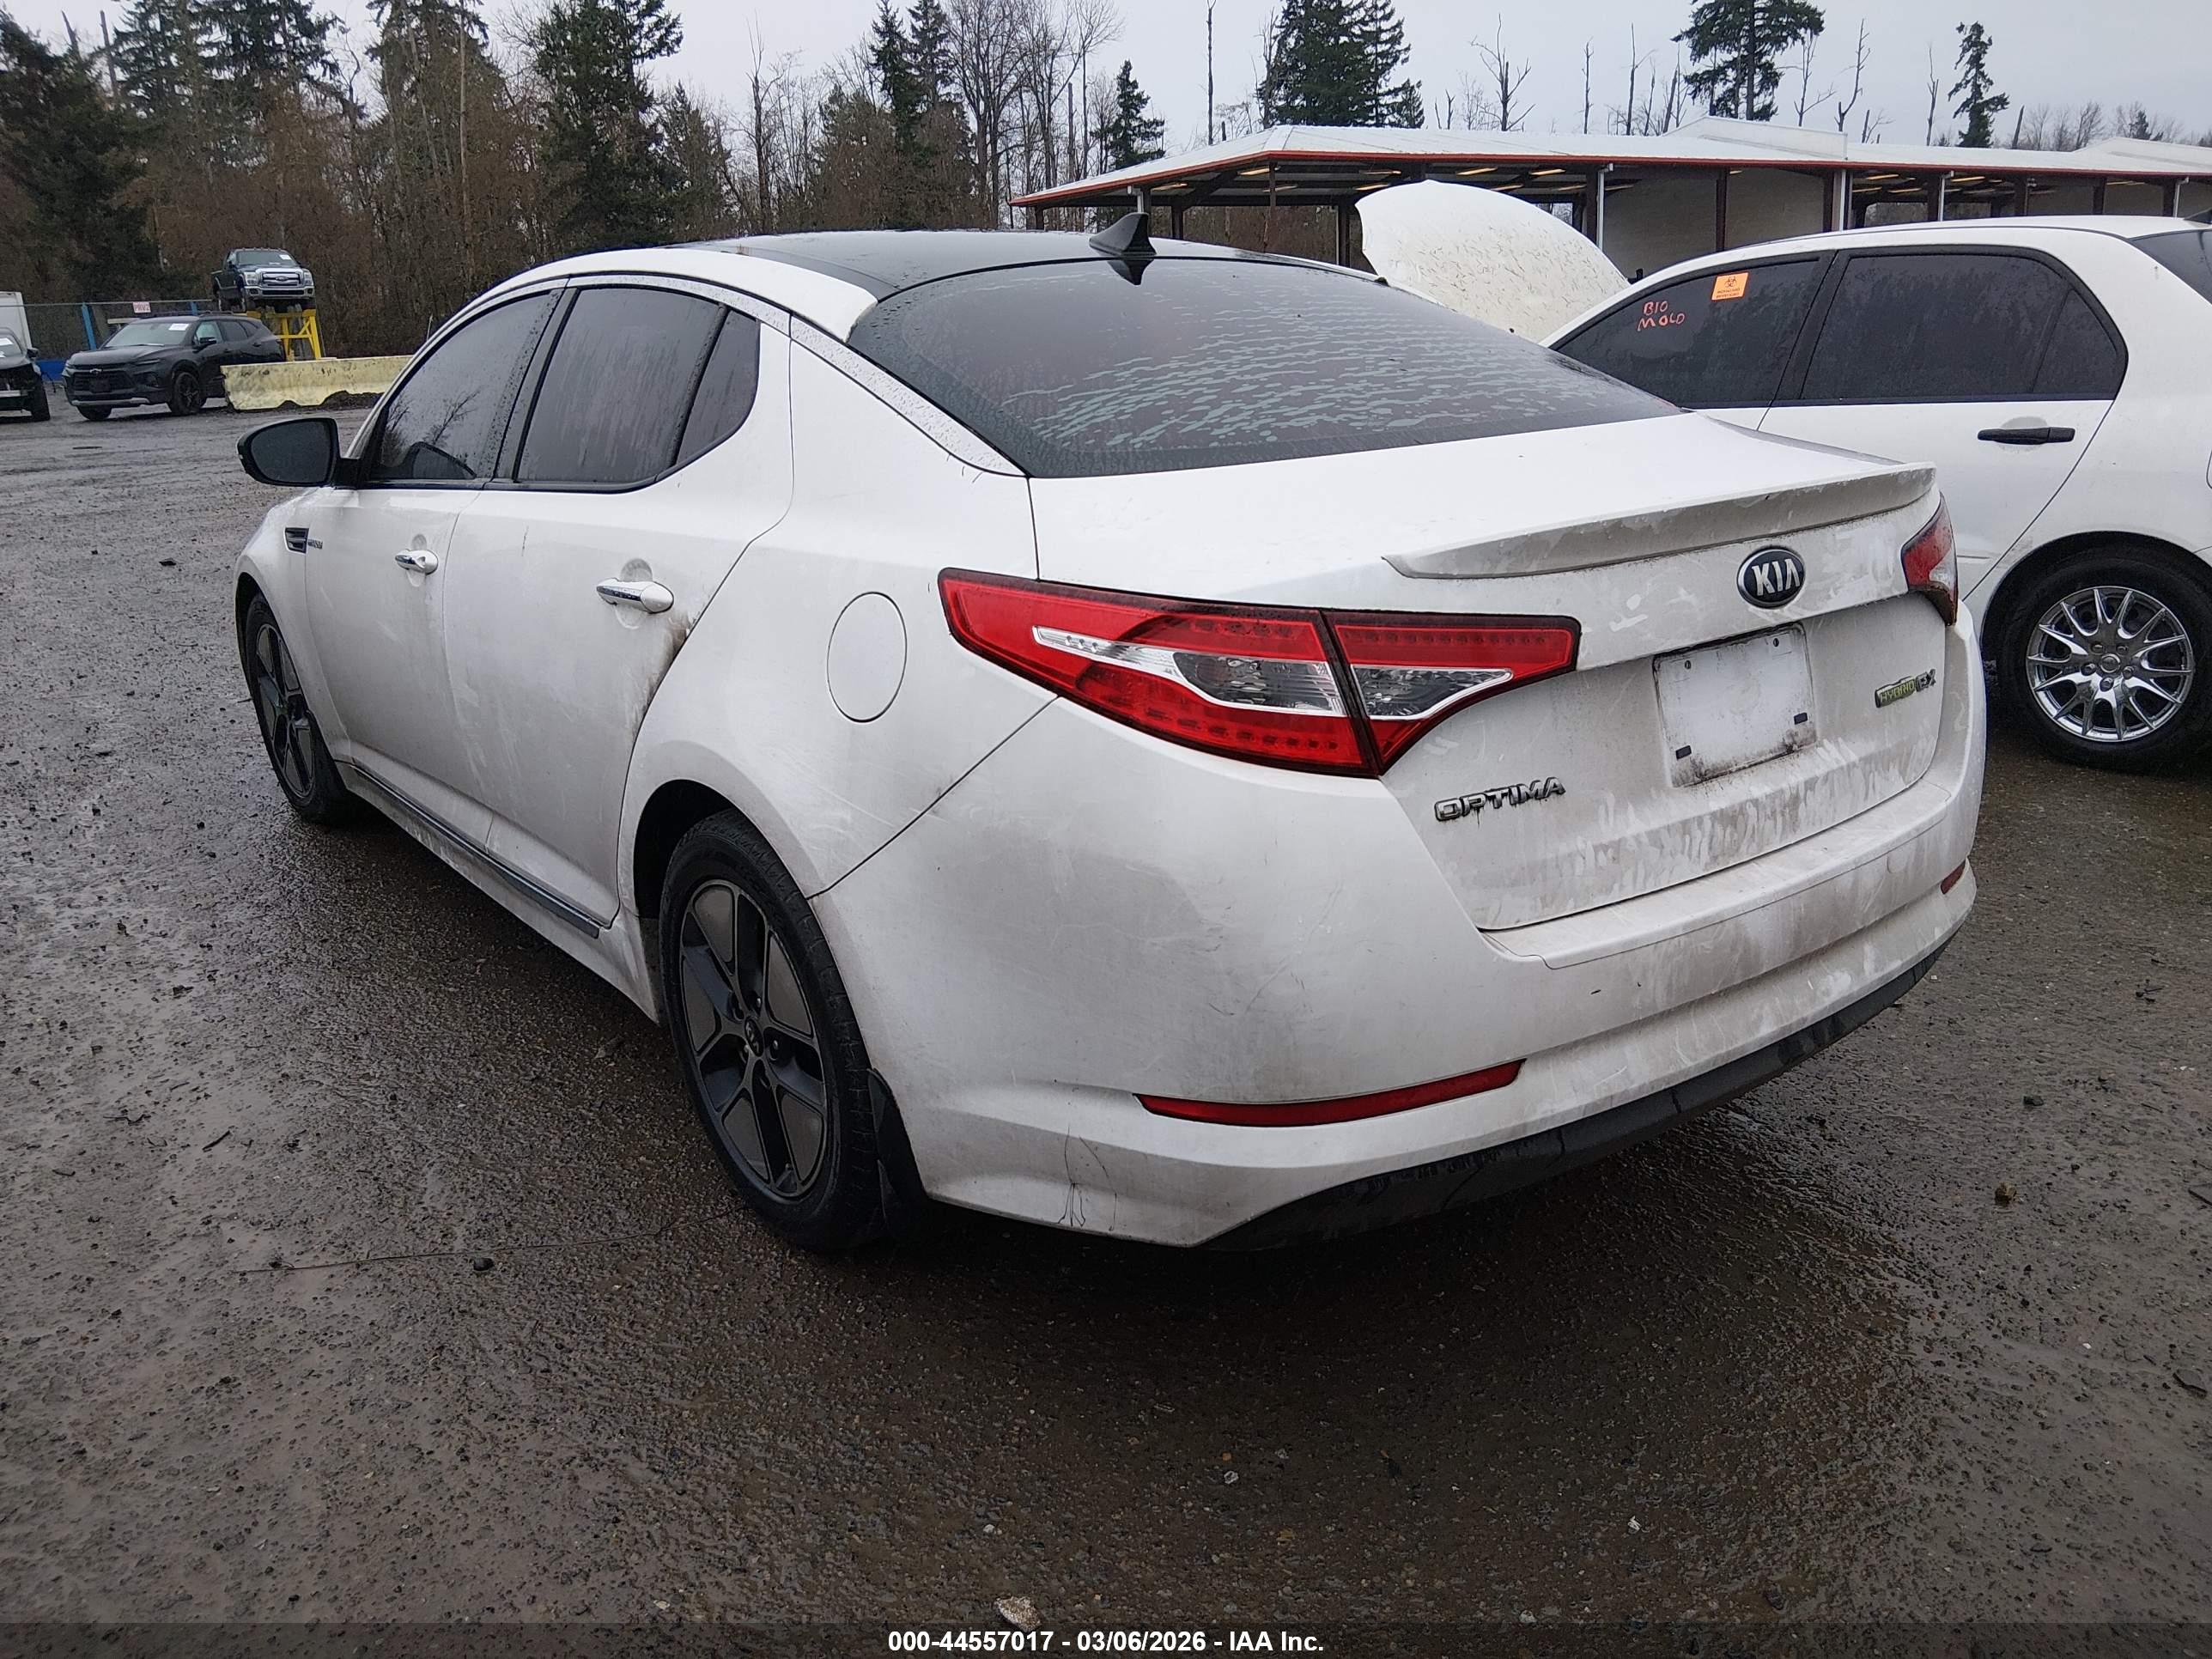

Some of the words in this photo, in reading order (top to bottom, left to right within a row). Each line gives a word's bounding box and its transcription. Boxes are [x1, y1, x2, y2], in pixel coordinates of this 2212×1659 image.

[1637, 313, 1686, 331] MOLD
[1643, 301, 1668, 316] BIO
[1751, 558, 1801, 596] KIA
[1878, 677, 1916, 703] HYBRID
[1915, 669, 1936, 692] EX
[1434, 776, 1566, 822] OPTIMA
